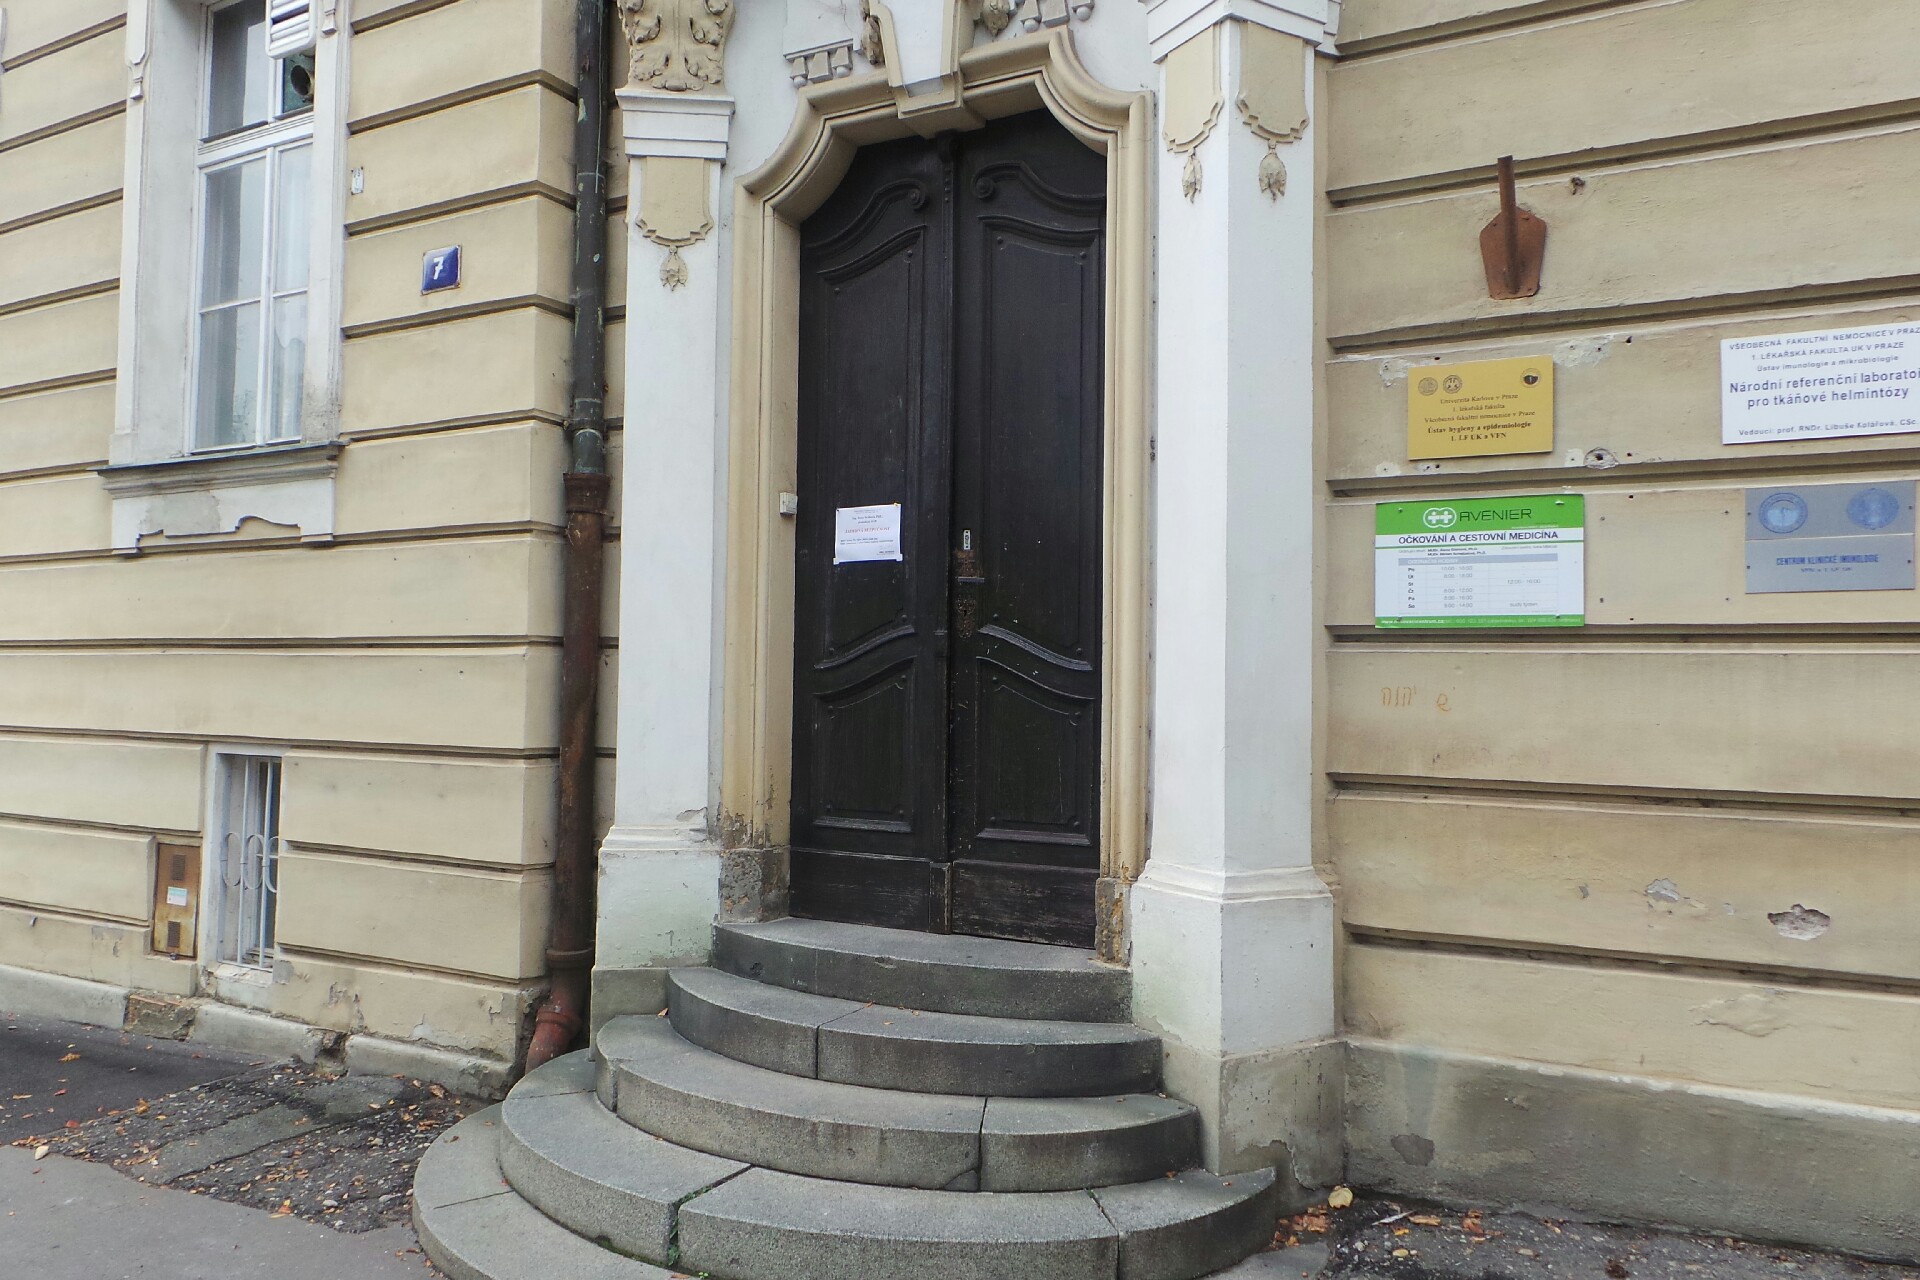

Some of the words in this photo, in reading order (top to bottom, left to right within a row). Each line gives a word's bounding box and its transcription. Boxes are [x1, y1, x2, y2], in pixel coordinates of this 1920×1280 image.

[433, 256, 444, 280] 7
[1729, 339, 1782, 350] VŠEOBECNÁ
[1786, 335, 1829, 346] FAKULTNÍ
[1833, 329, 1887, 341] NEMOCNICE
[1809, 346, 1849, 356] FAKULTA
[1851, 344, 1864, 352] UK
[1874, 341, 1905, 350] PRAZE
[1782, 360, 1829, 369] imunologie
[1839, 355, 1899, 365] mikrobiologie
[1730, 379, 1782, 393] Národní
[1786, 373, 1858, 389] referenční
[1747, 398, 1770, 410] pro
[1773, 391, 1827, 406] tkáňové
[1831, 387, 1909, 402] helmintózy
[1448, 424, 1475, 433] hygieny
[1483, 421, 1532, 431] epidemiologie
[1459, 508, 1532, 522] AVENIER
[1398, 534, 1447, 545] OČKOVÁNÍ
[1449, 534, 1456, 543] A
[1458, 530, 1507, 543] CESTOVNÍ
[1508, 531, 1559, 541] MEDICÍNA
